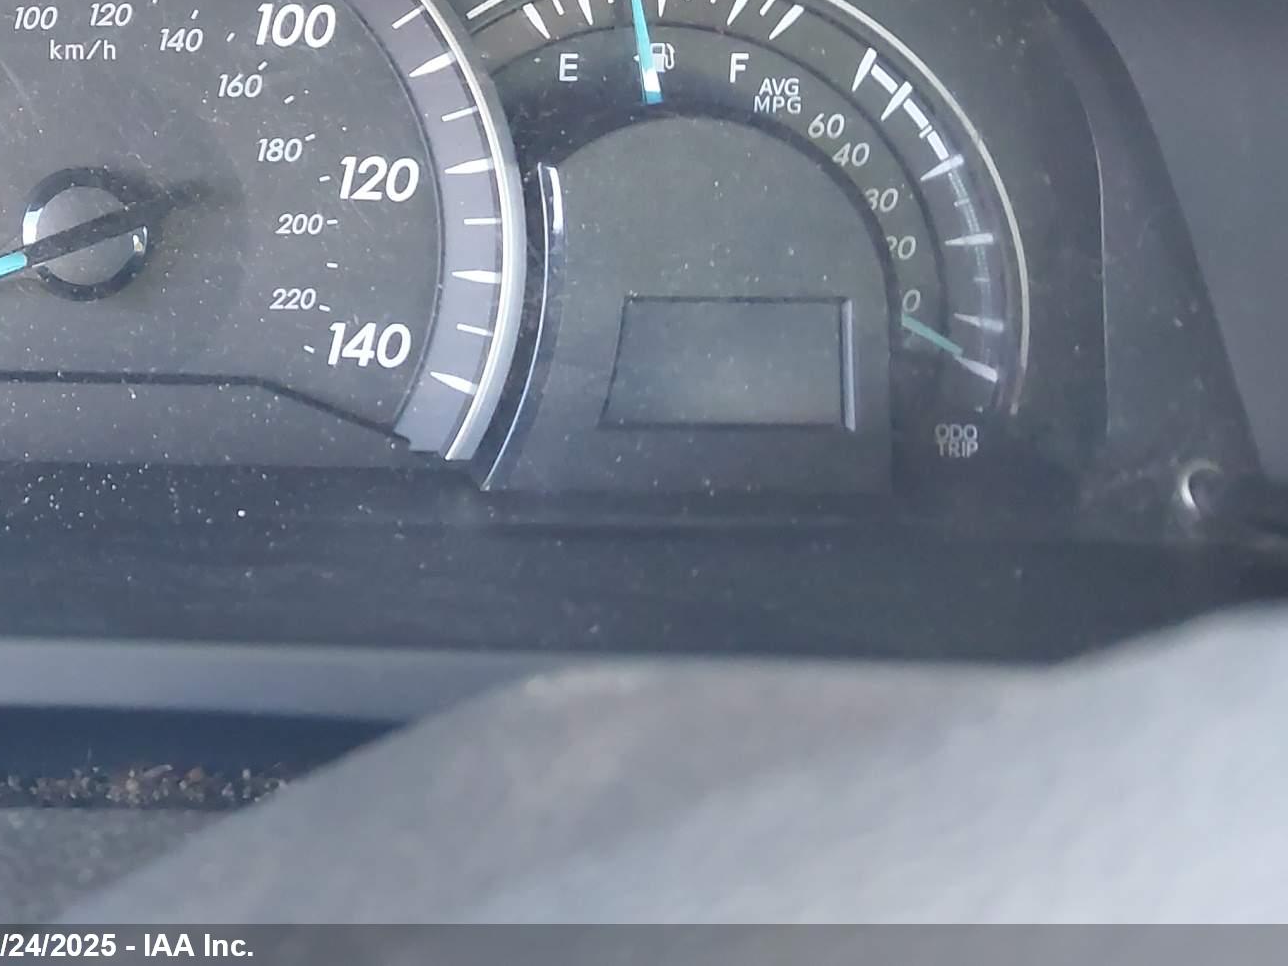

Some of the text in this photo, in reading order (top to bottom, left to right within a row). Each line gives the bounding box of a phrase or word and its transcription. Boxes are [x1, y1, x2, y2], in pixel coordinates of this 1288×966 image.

[14, 6, 58, 30] 100
[90, 2, 133, 27] 120
[255, 3, 336, 49] 100
[50, 39, 116, 60] km/h
[159, 28, 204, 52] 140
[559, 53, 579, 82] E
[729, 52, 750, 83] F
[218, 73, 263, 98] 160
[758, 77, 801, 99] AVG
[754, 93, 802, 114] MPG
[808, 113, 845, 138] 60
[258, 138, 303, 163] 180
[832, 142, 870, 167] 40
[339, 155, 420, 202] 120
[865, 187, 899, 213] 30
[275, 213, 324, 235] 200
[269, 288, 317, 310] 220
[902, 289, 921, 313] 0
[327, 322, 411, 368] 140
[934, 423, 979, 441] ODO
[938, 439, 979, 458] TRIP
